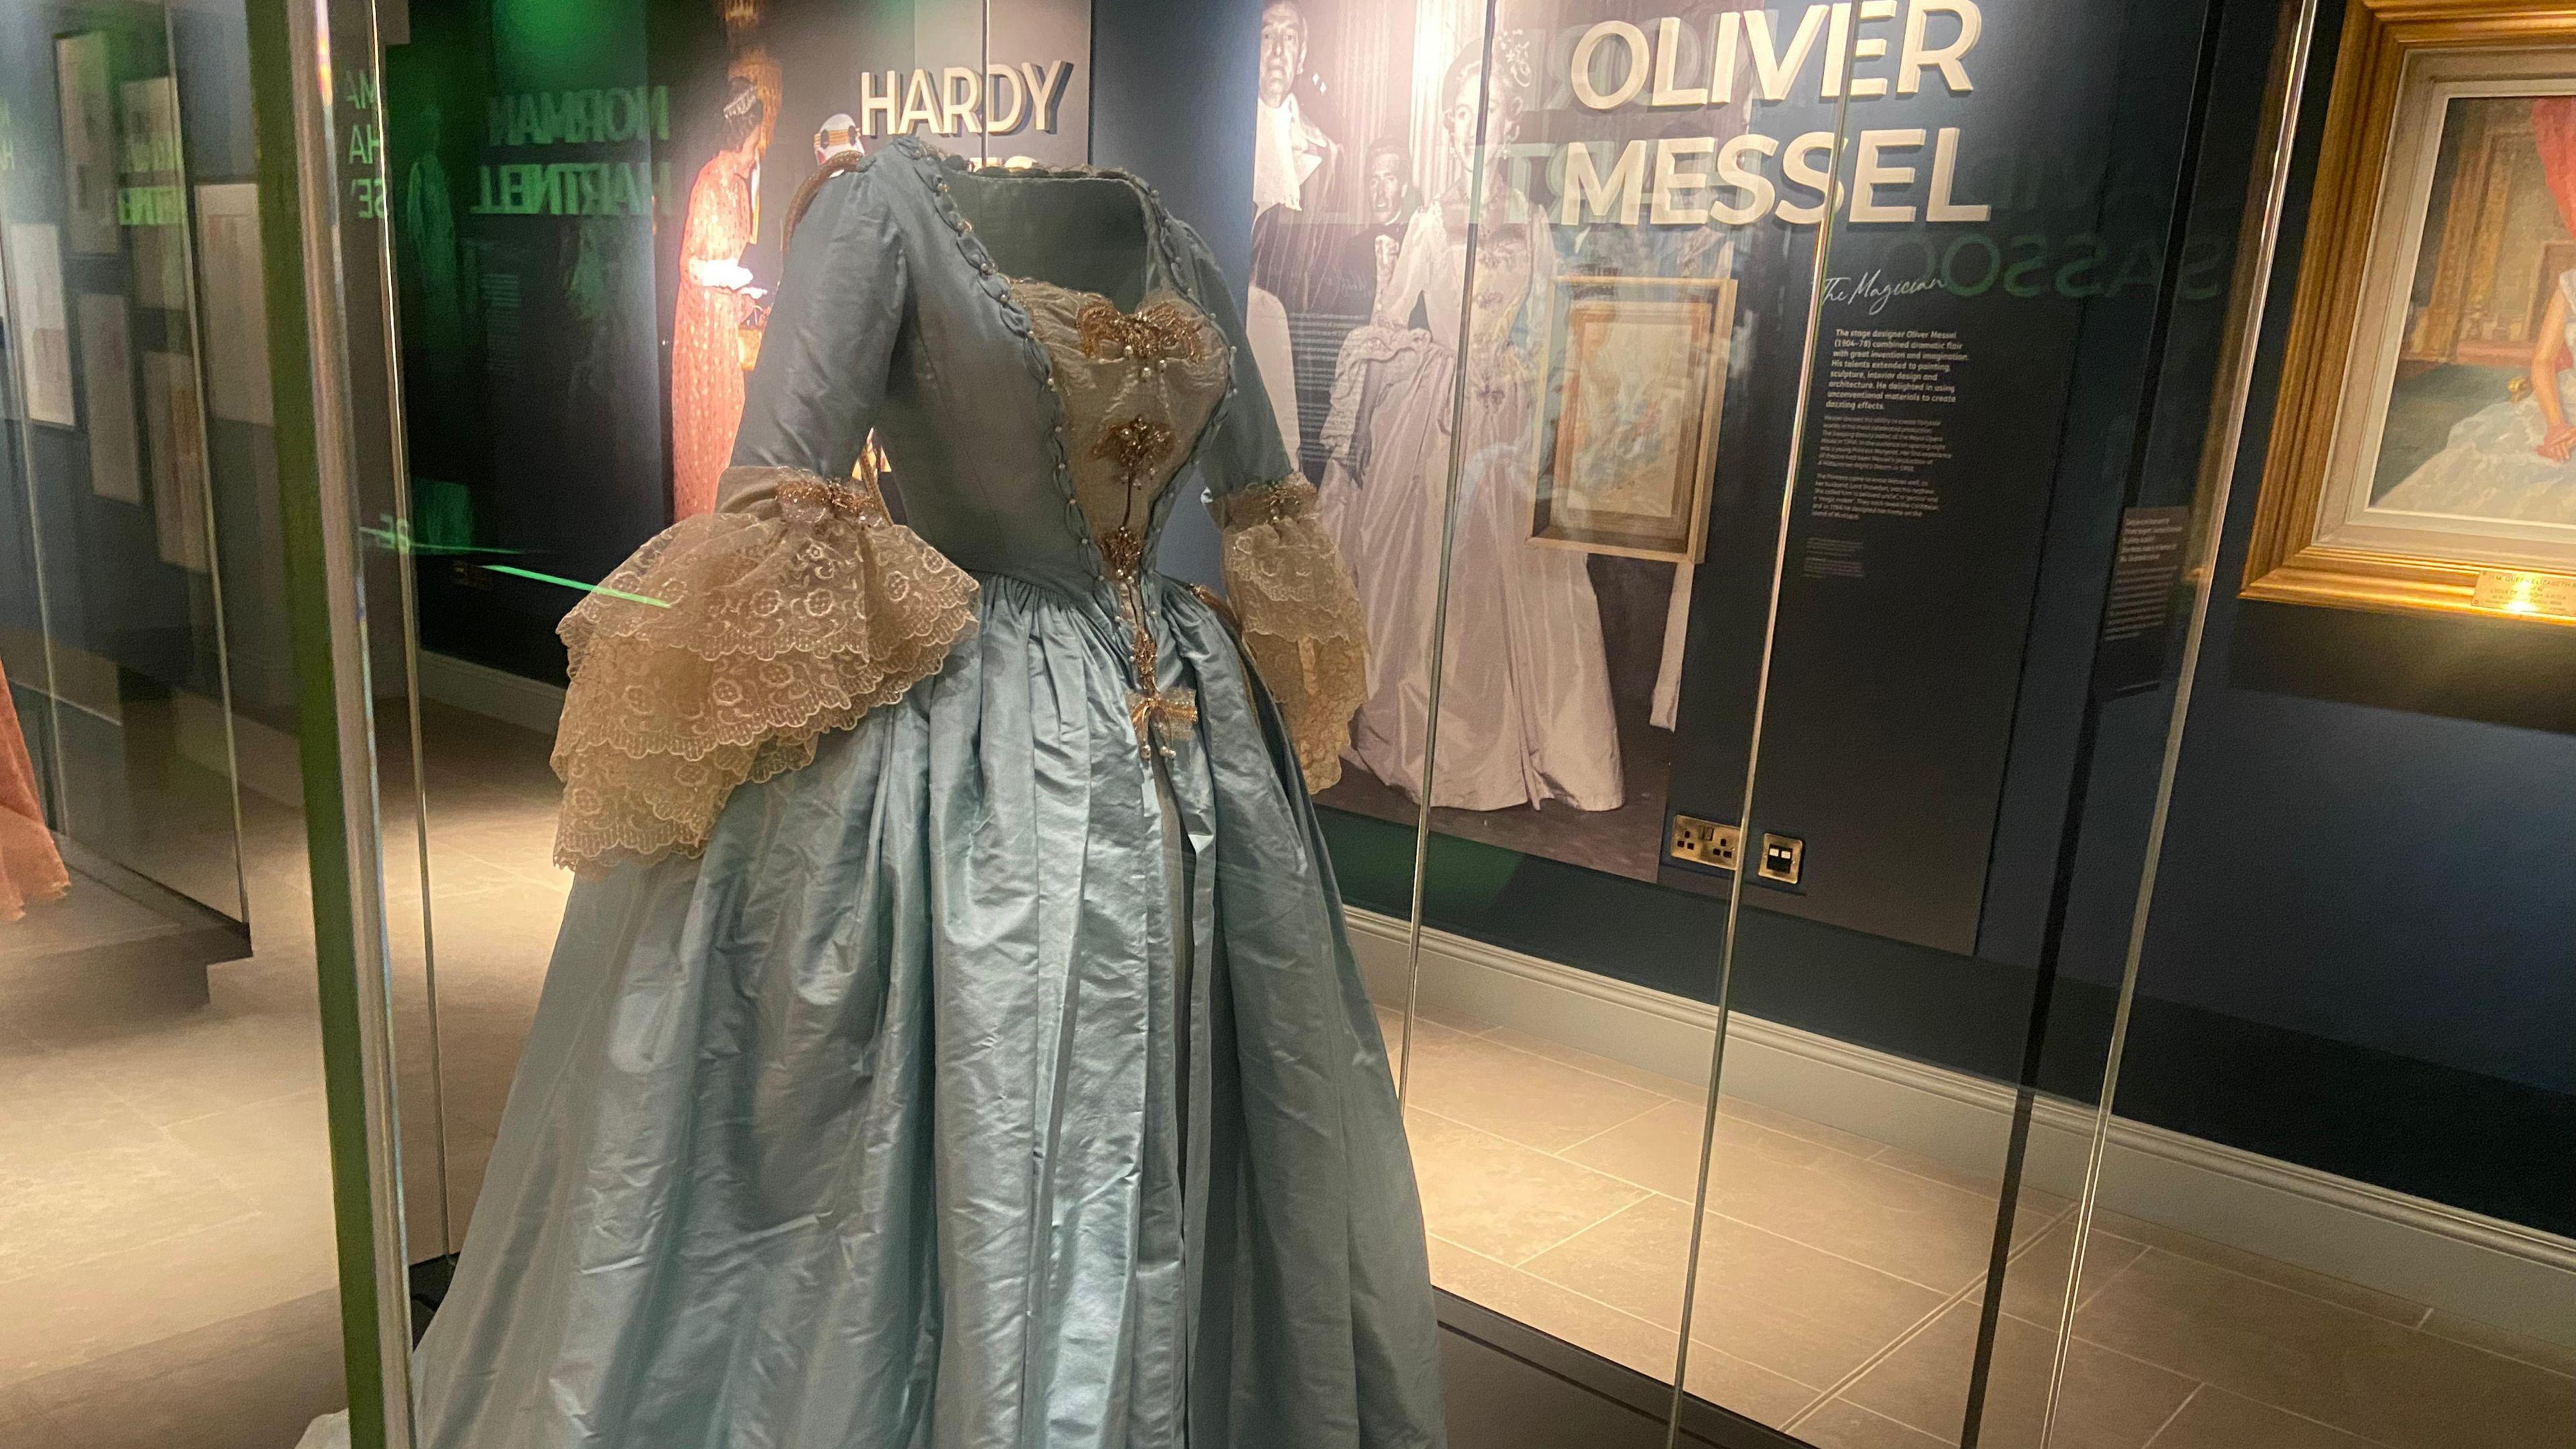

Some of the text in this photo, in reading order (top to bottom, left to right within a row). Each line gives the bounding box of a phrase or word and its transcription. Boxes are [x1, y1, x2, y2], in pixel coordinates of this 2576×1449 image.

[1571, 0, 1982, 110] OLIVER
[861, 60, 1073, 138] HARDY
[1560, 127, 1992, 226] MESSEL
[1811, 268, 1945, 315] The Magician
[1836, 329, 1957, 339] The stage designer Oliver Messel
[1872, 341, 1910, 349] combined
[1912, 341, 1945, 350] dramatic
[1896, 372, 1921, 381] design
[1888, 382, 1924, 392] delighted
[1934, 385, 1955, 393] using
[1827, 391, 1882, 399] unconventional
[1885, 392, 1919, 400] materials
[1826, 400, 1855, 410] dazzling
